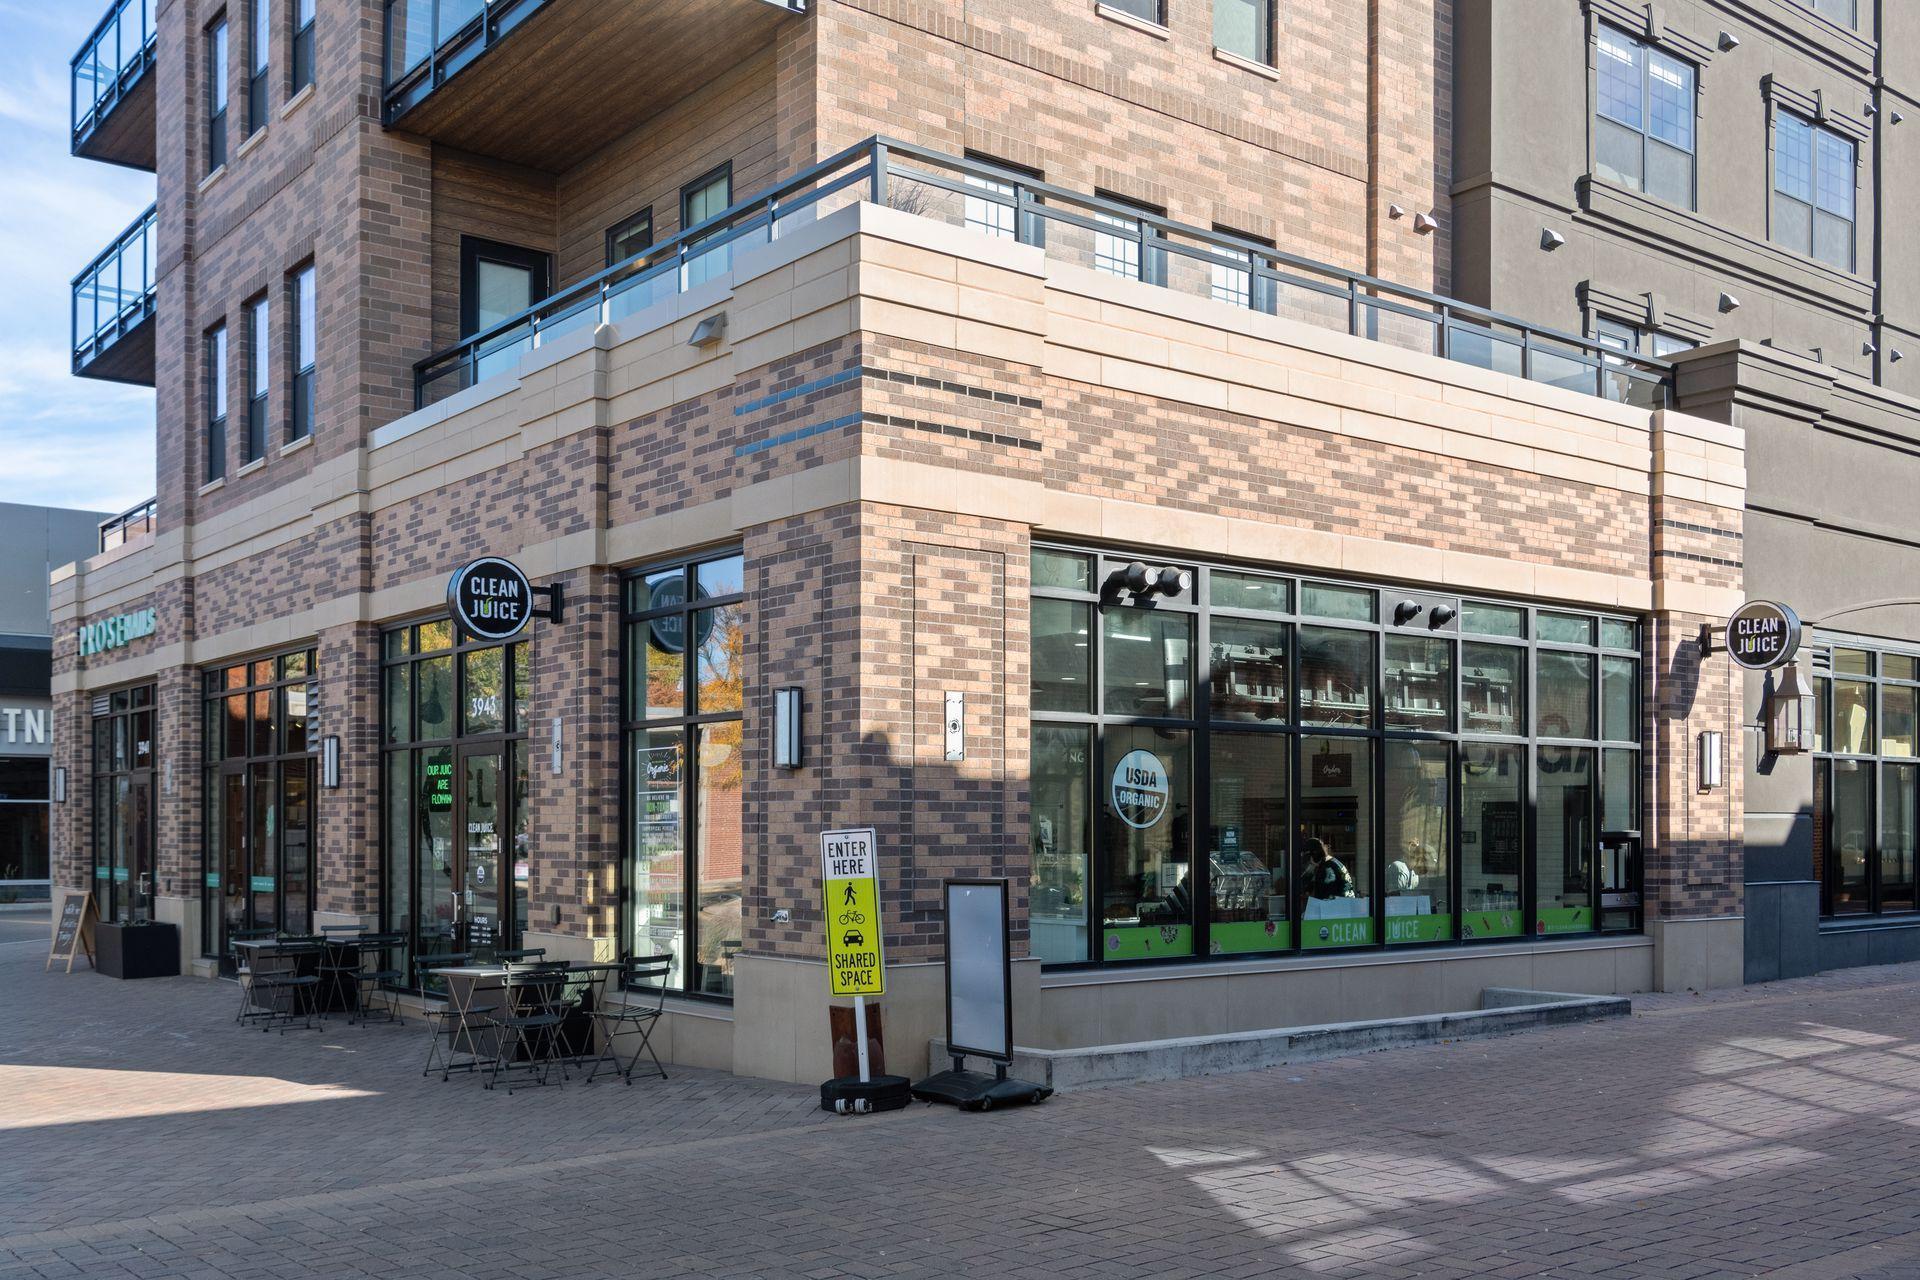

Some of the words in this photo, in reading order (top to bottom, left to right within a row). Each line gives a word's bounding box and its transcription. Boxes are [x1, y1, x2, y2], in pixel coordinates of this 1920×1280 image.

[470, 576, 519, 598] CLEAN
[470, 598, 519, 620] JUICE
[1738, 617, 1778, 635] CLEAN
[1737, 635, 1779, 655] JUICE
[471, 695, 497, 718] 3943
[2, 708, 54, 744] TN
[1126, 767, 1158, 788] USDA
[1120, 790, 1160, 809] ORGANIC
[468, 822, 480, 833] CLEAN
[481, 822, 494, 833] JUICE
[828, 841, 867, 858] ENTER
[833, 858, 865, 875] HERE
[1331, 922, 1367, 942] CLEAN
[1386, 920, 1420, 940] JUICE
[835, 952, 876, 969] SHARED
[840, 970, 874, 987] SPACE
